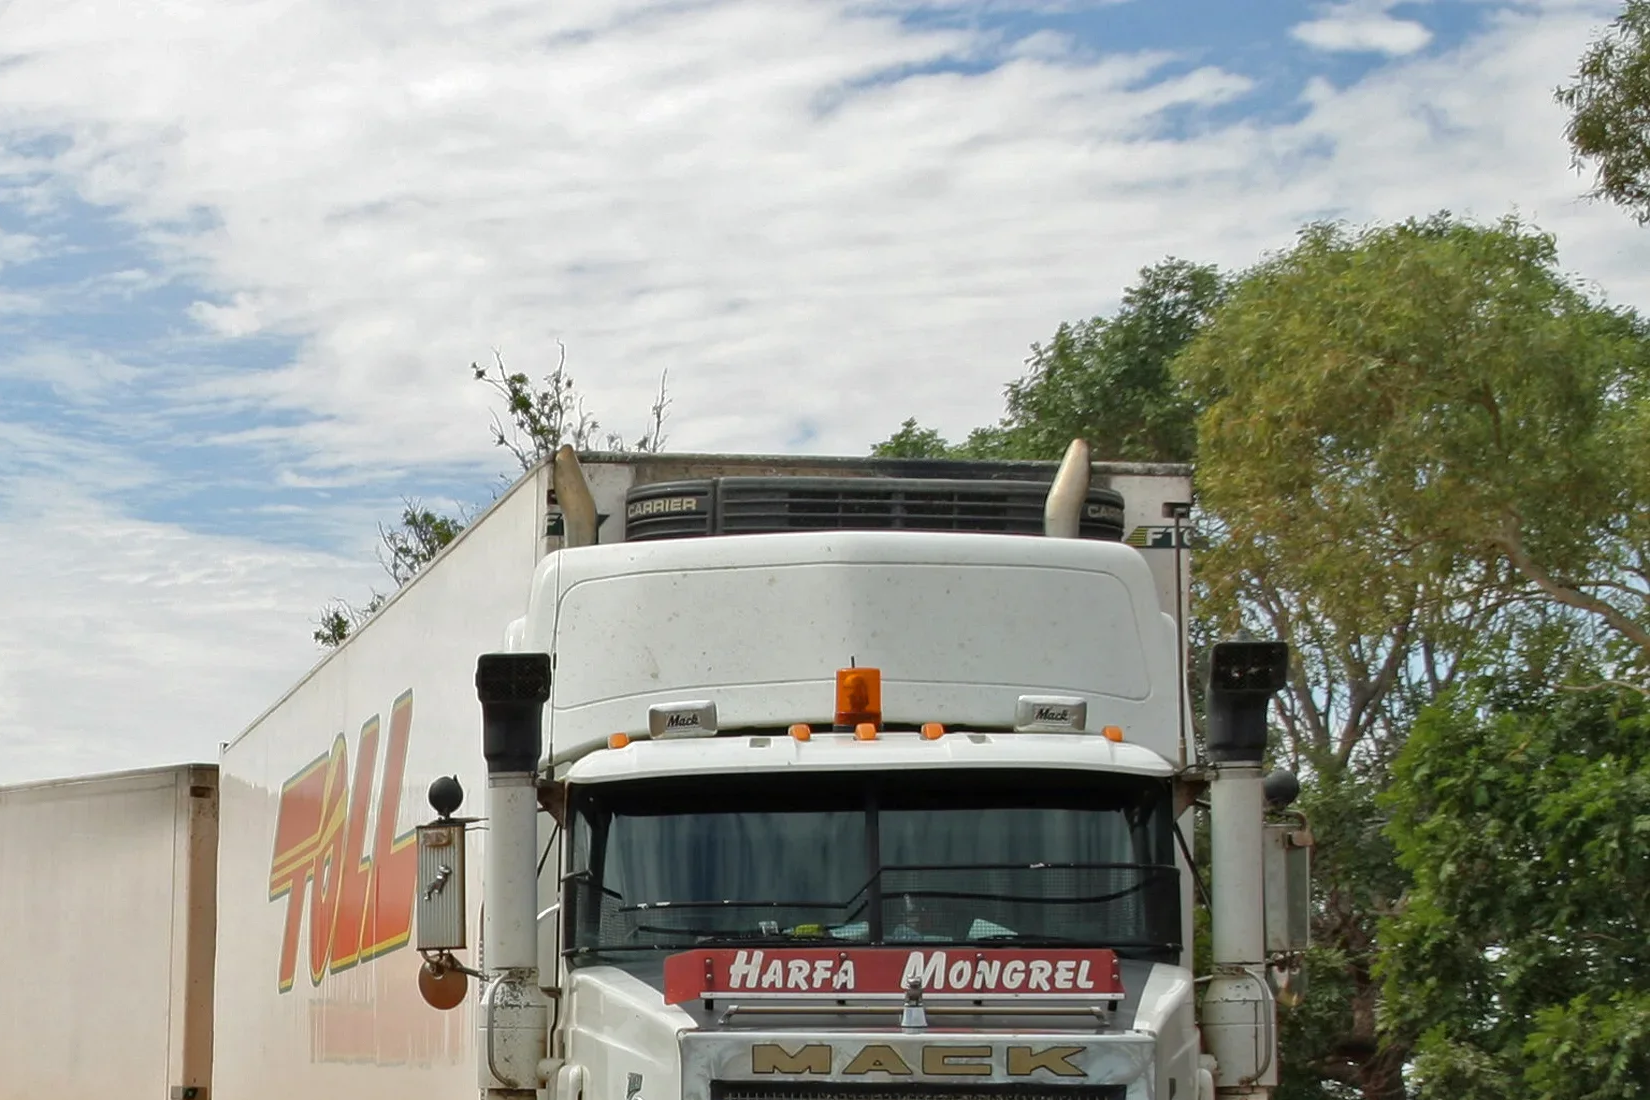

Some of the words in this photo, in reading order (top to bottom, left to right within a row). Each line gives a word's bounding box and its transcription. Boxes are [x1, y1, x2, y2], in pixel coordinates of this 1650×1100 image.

[627, 498, 698, 518] CARRIER
[666, 713, 700, 728] Mack
[1035, 707, 1069, 722] Mack
[268, 687, 418, 995] TOLL
[728, 950, 857, 991] HARFA
[900, 950, 1096, 991] MONGREL
[751, 1043, 1089, 1078] MACK
